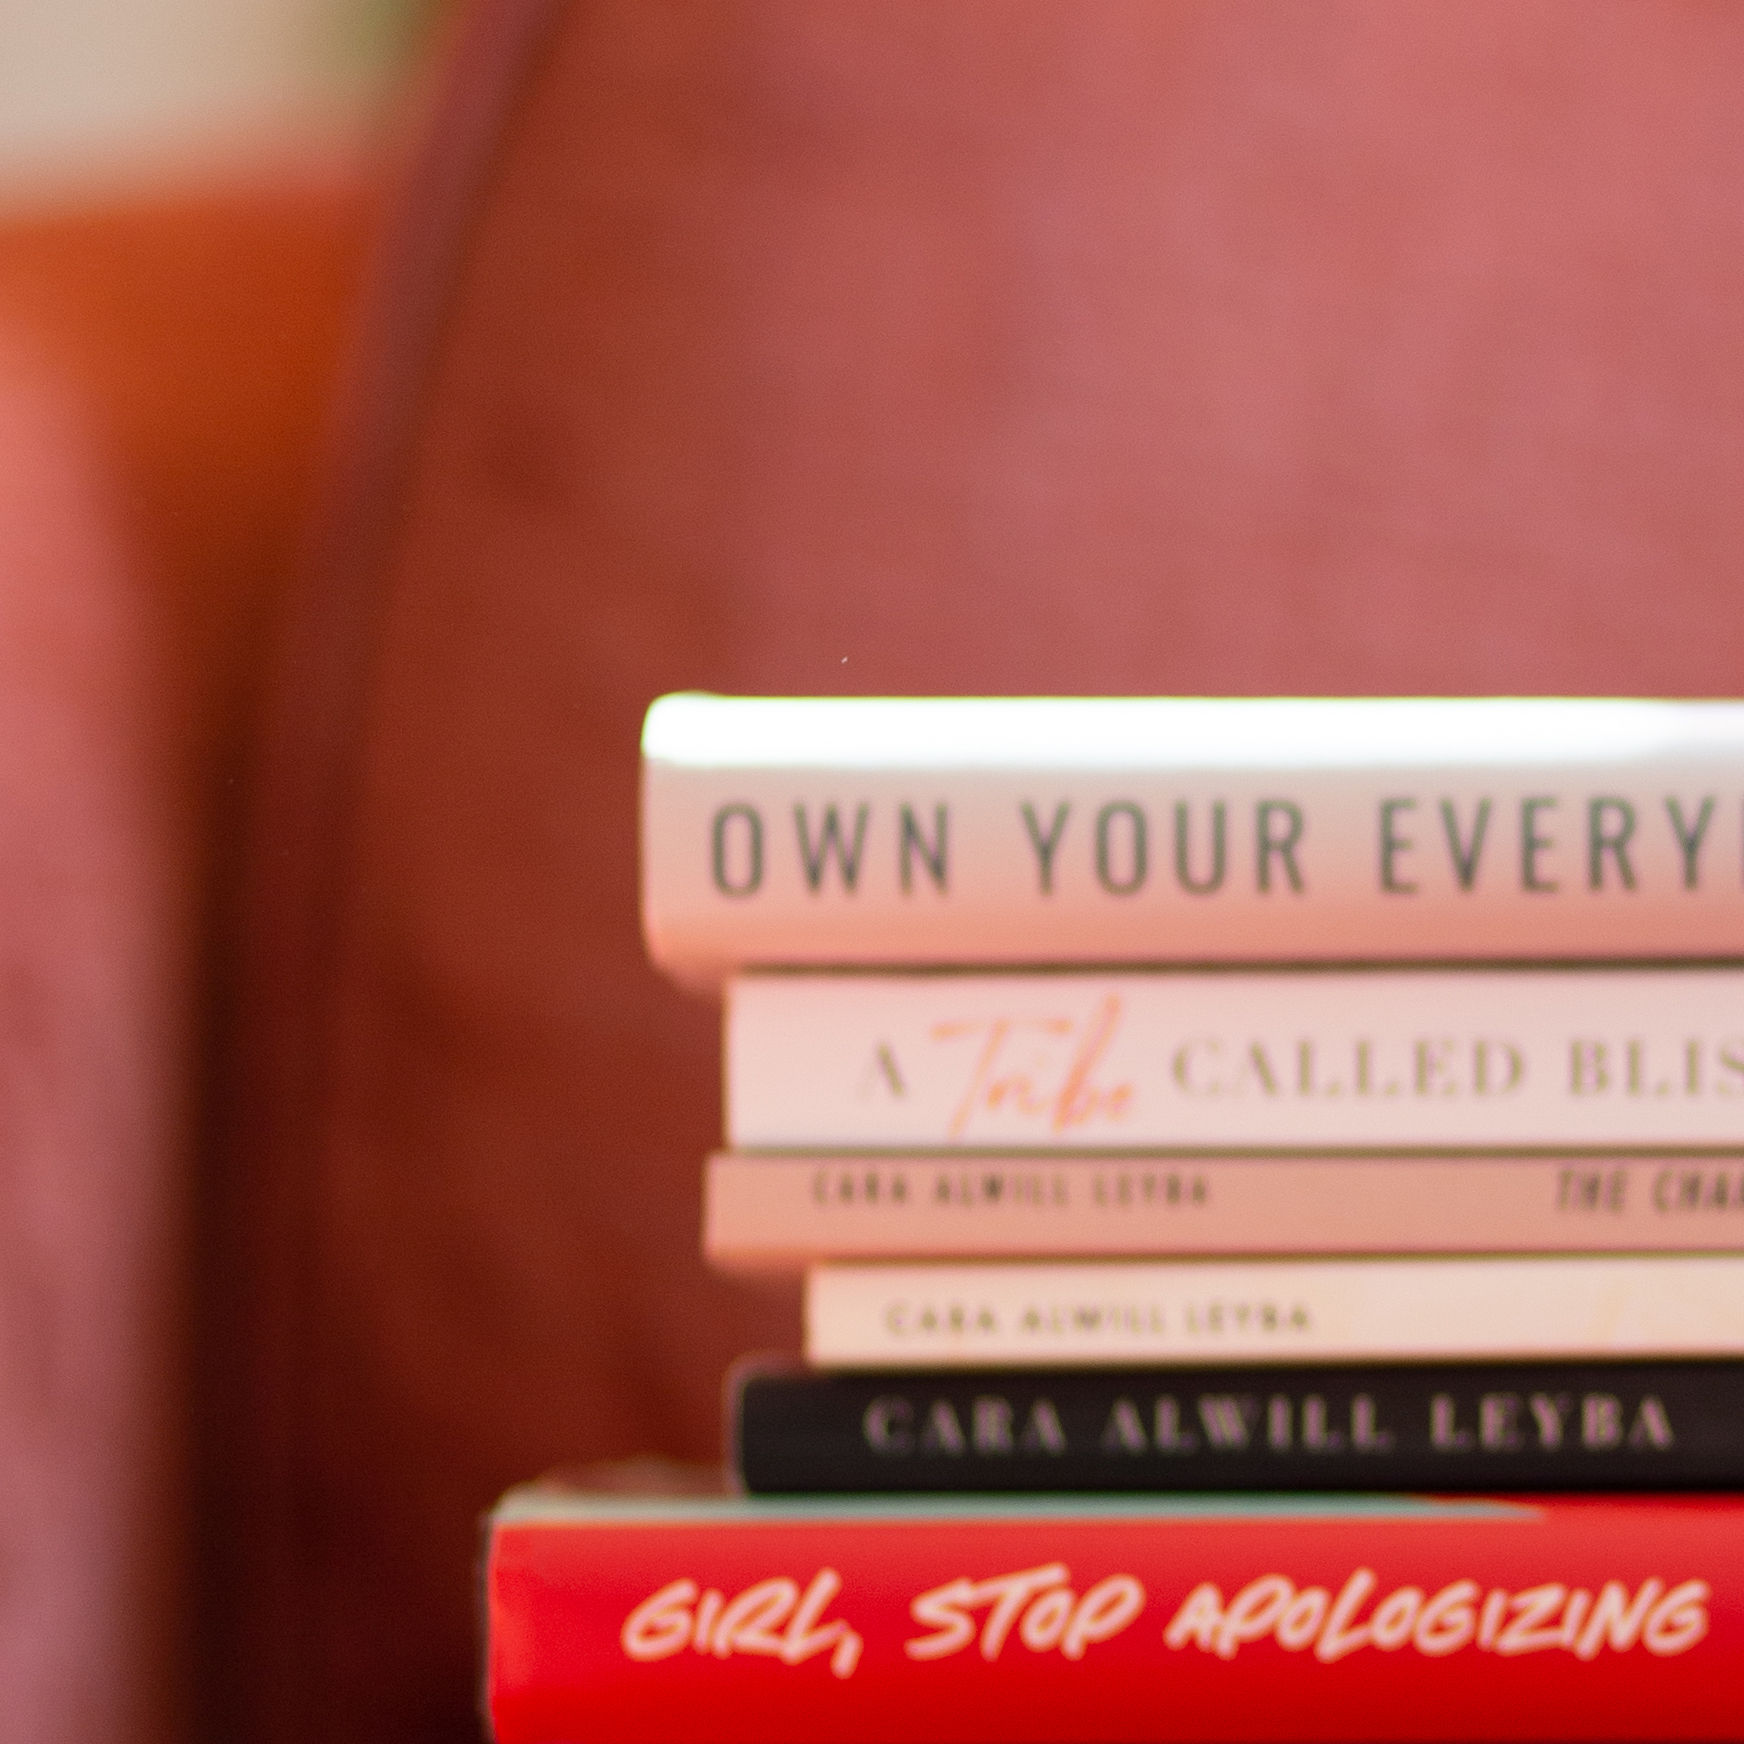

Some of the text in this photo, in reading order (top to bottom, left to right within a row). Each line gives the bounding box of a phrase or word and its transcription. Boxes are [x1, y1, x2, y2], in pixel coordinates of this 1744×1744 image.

[710, 800, 950, 897] OWN
[1020, 799, 1306, 896] YOUR
[860, 1043, 908, 1099] A
[1171, 1037, 1526, 1099] CALLED
[812, 1170, 907, 1207] CARA
[934, 1170, 1070, 1207] ALWILL
[1093, 1169, 1209, 1206] LEYBA
[1555, 1169, 1628, 1213] THE
[885, 1303, 998, 1336] CARA
[1021, 1302, 1166, 1335] ALWILL
[1186, 1301, 1311, 1334] LEYBA
[863, 1396, 1068, 1454] CARA
[1105, 1396, 1394, 1453] ALWILL
[1428, 1393, 1675, 1452] LEYBA
[621, 1568, 863, 1678] GIRL,
[903, 1564, 1145, 1660] STOP
[1163, 1567, 1711, 1663] APOLOGIZING
